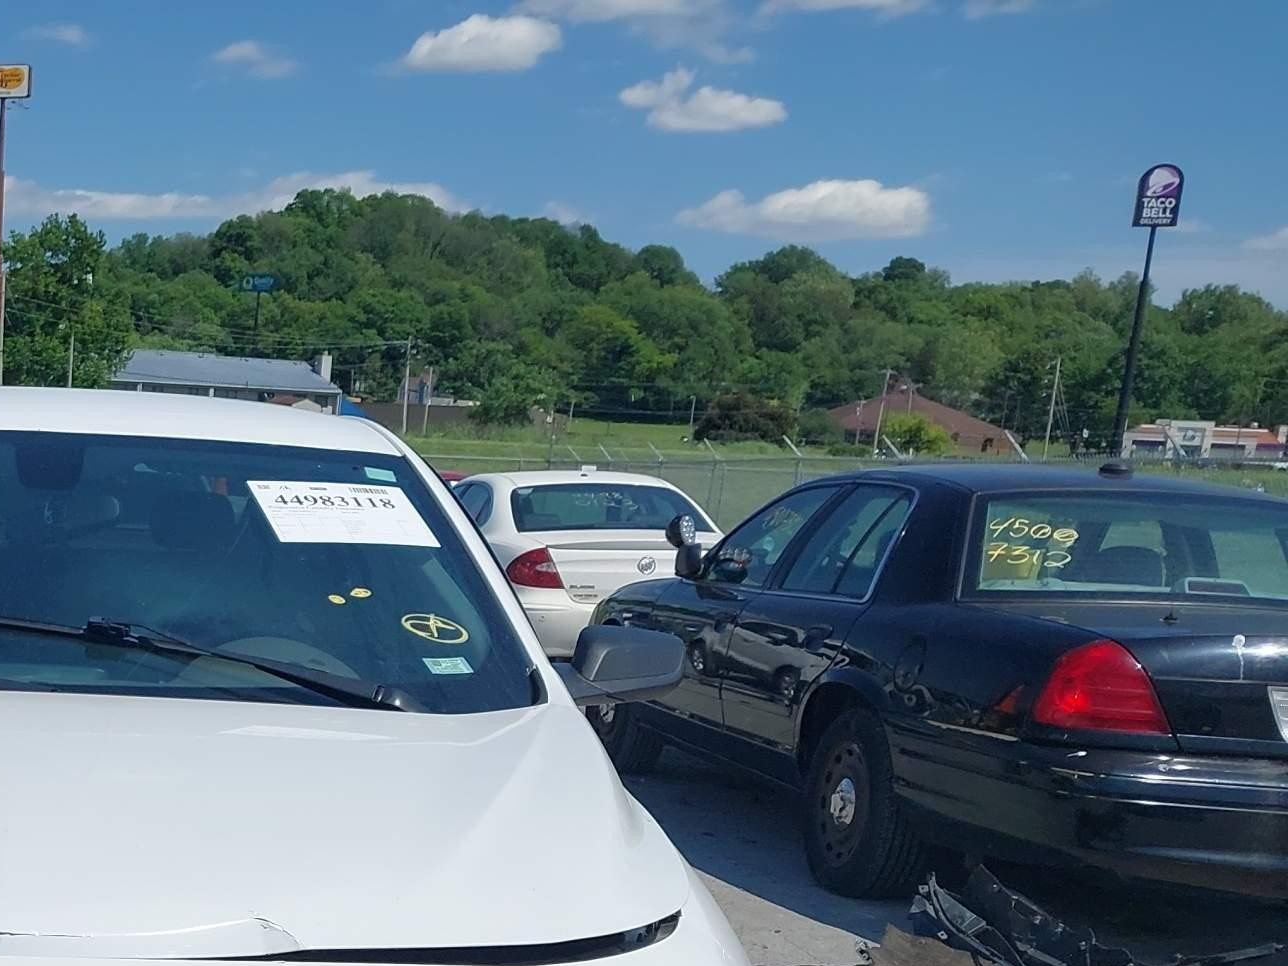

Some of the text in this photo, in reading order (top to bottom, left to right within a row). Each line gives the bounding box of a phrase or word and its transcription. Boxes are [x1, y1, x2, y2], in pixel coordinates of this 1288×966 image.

[1142, 197, 1176, 208] TACO
[1142, 207, 1173, 218] BELL
[274, 493, 396, 510] 44983118
[987, 542, 1072, 569] 7312
